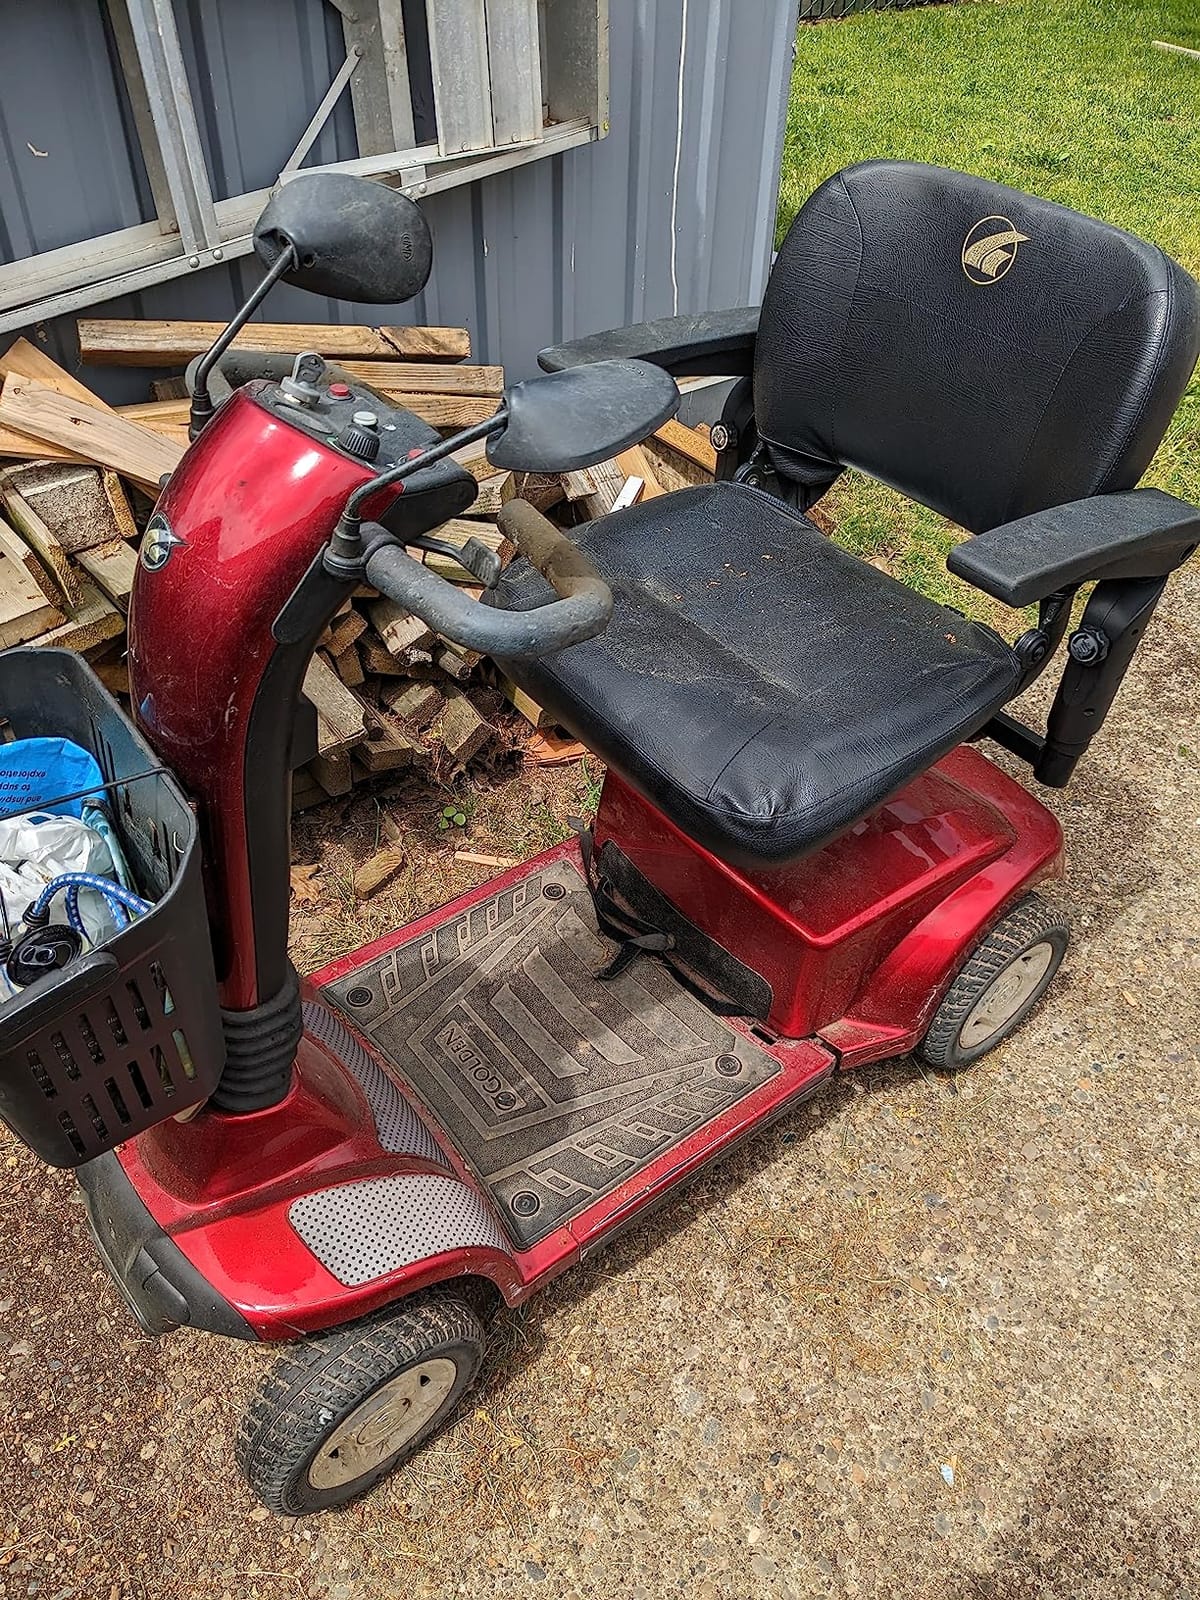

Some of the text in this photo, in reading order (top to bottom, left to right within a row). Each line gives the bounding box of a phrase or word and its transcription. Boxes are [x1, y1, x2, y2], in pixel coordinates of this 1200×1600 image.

[21, 783, 31, 791] to
[25, 796, 41, 805] and
[439, 1027, 502, 1094] GOLDEN
